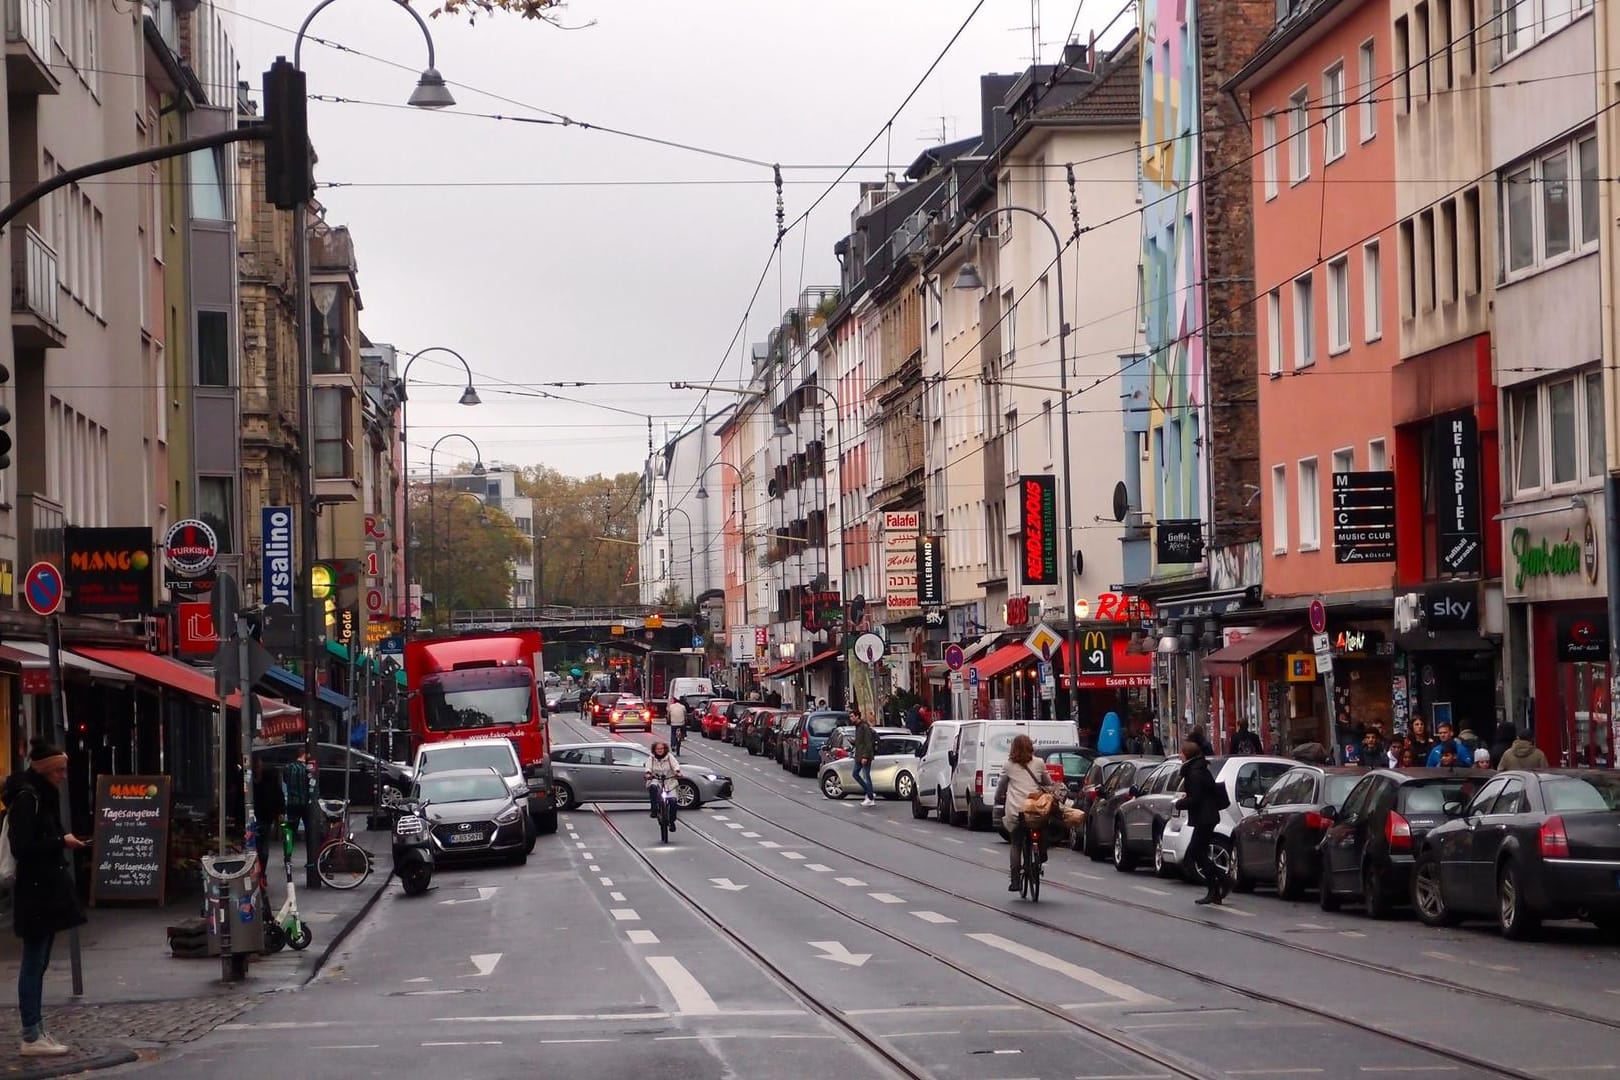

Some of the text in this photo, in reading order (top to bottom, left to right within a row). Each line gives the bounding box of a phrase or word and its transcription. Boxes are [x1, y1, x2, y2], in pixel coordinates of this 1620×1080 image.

[1453, 421, 1465, 530] HEIMSPIEL
[887, 514, 917, 527] Falafel
[1026, 480, 1043, 580] RENDEZVOUS
[1368, 532, 1391, 540] CLUB
[172, 547, 209, 556] TURKISH
[1452, 541, 1478, 568] Karaoke
[925, 542, 933, 598] HILLEBRAND
[888, 594, 917, 607] Schawarm
[1433, 596, 1471, 620] sky
[1106, 677, 1127, 686] Essen
[1129, 677, 1136, 686] &
[102, 808, 160, 821] Tagesangebot
